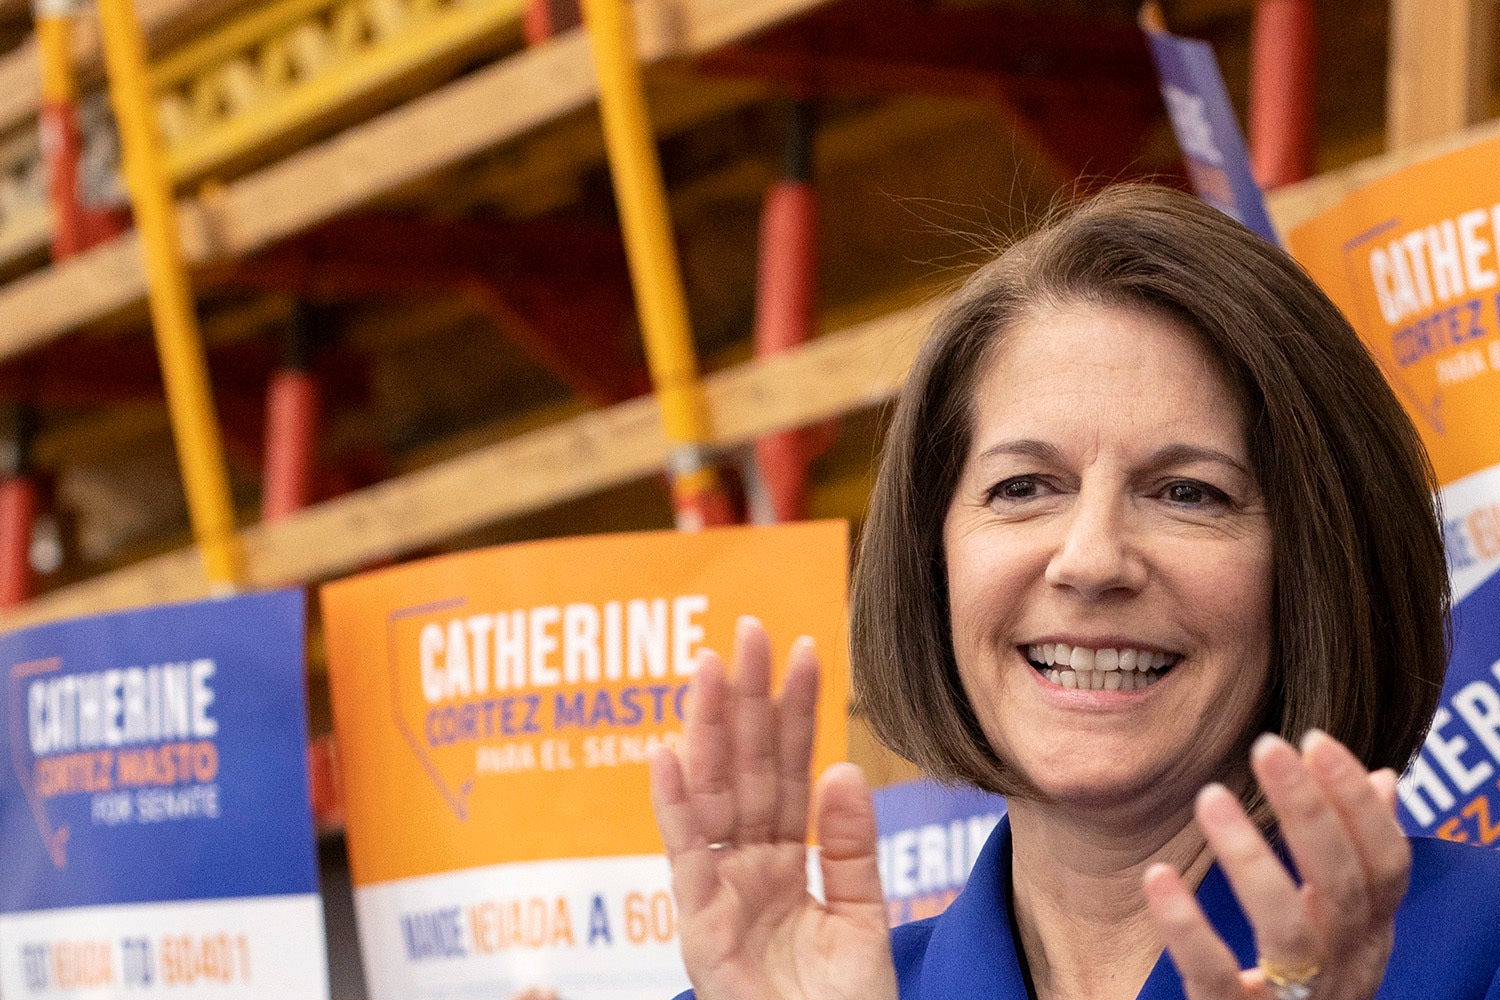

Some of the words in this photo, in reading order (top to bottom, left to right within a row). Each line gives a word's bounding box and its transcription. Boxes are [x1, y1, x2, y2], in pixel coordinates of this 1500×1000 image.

[420, 595, 709, 702] CATHERINE
[28, 659, 218, 756] CATHERINE
[426, 694, 541, 747] CORTEZ
[588, 893, 613, 946] A
[161, 930, 251, 985] 60401
